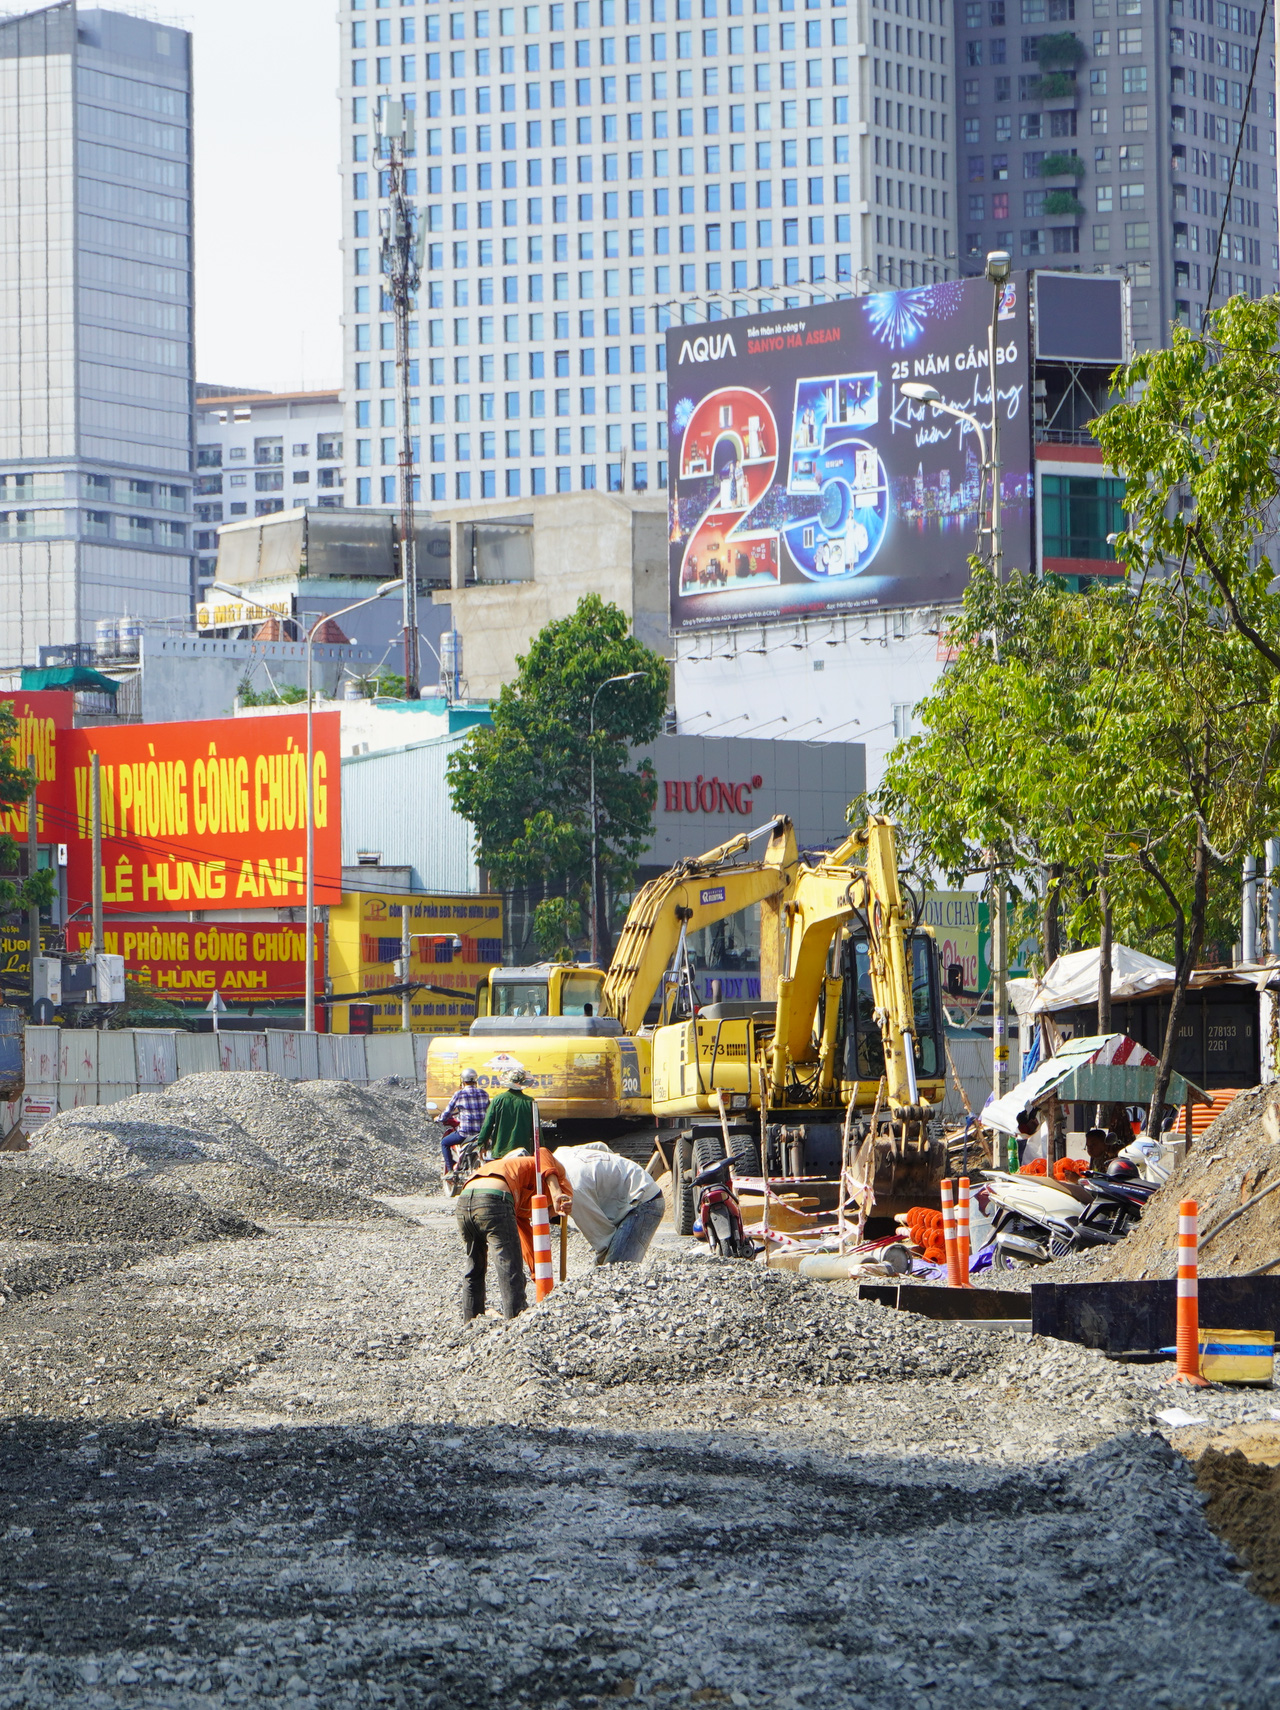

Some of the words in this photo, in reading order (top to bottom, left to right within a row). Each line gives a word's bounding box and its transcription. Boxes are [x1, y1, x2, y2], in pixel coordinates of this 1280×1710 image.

[760, 324, 775, 336] thân
[775, 323, 781, 335] là
[782, 323, 799, 334] công
[799, 321, 806, 331] ty
[678, 333, 737, 365] AQUA
[747, 336, 784, 355] SANYO
[786, 333, 803, 349] HA
[805, 327, 841, 346] ASEAN
[891, 360, 910, 380] 25
[914, 353, 950, 377] NĂM
[955, 344, 989, 371] GẮN
[996, 341, 1018, 365] BÓ
[119, 743, 189, 838] PHÒNG
[193, 742, 249, 836] CÔNG
[255, 737, 327, 833] CHỨNG
[663, 774, 754, 815] HƯƠNG
[101, 854, 134, 903] LÊ
[142, 854, 226, 901] HÙNG
[235, 857, 304, 898] ANH
[389, 902, 402, 918] CÔN
[946, 900, 976, 926] CHAY
[0, 937, 46, 953] HUOG
[124, 926, 189, 961] PHÒNG
[194, 927, 247, 961] CÔNG
[157, 966, 216, 988] HÙNG
[221, 971, 267, 988] ANH
[704, 978, 744, 998] BDY
[1208, 1026, 1237, 1037] 278133
[1208, 1040, 1228, 1051] 22G1
[622, 1078, 638, 1092] 200
